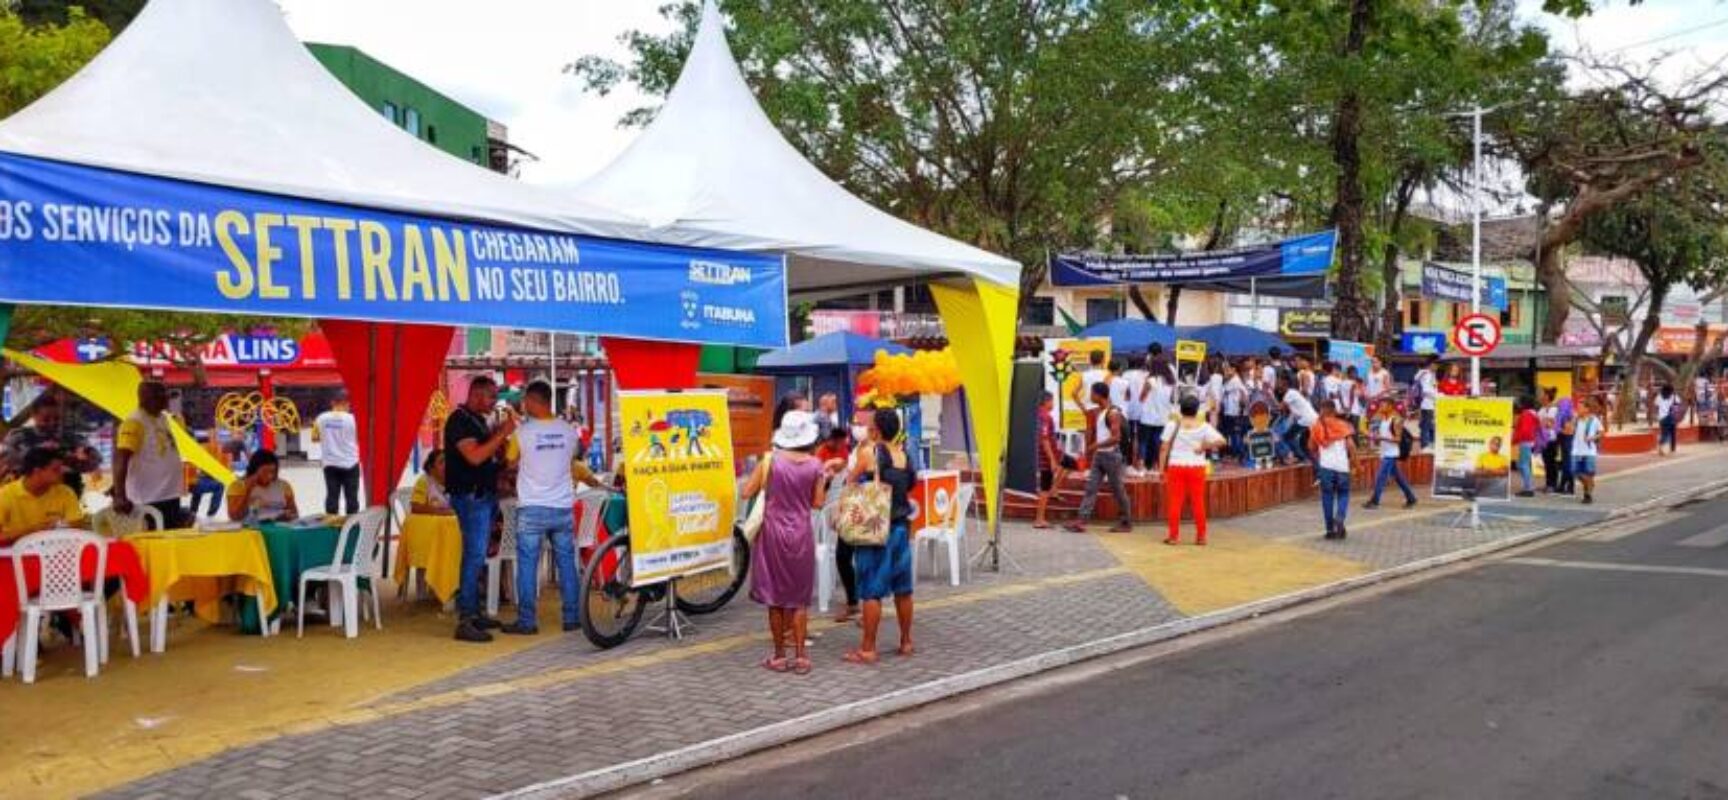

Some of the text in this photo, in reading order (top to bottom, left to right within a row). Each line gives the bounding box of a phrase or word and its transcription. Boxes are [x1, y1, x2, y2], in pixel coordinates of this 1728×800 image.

[42, 203, 172, 252] SERVIÇOS
[179, 214, 212, 248] DA
[213, 209, 472, 302] SETTRAN
[471, 230, 580, 263] CHEGARAM
[475, 267, 627, 304] NO SEU BAIRRO.
[703, 304, 756, 323] ITABUNA
[1467, 323, 1485, 347] E
[237, 338, 296, 361] LINS
